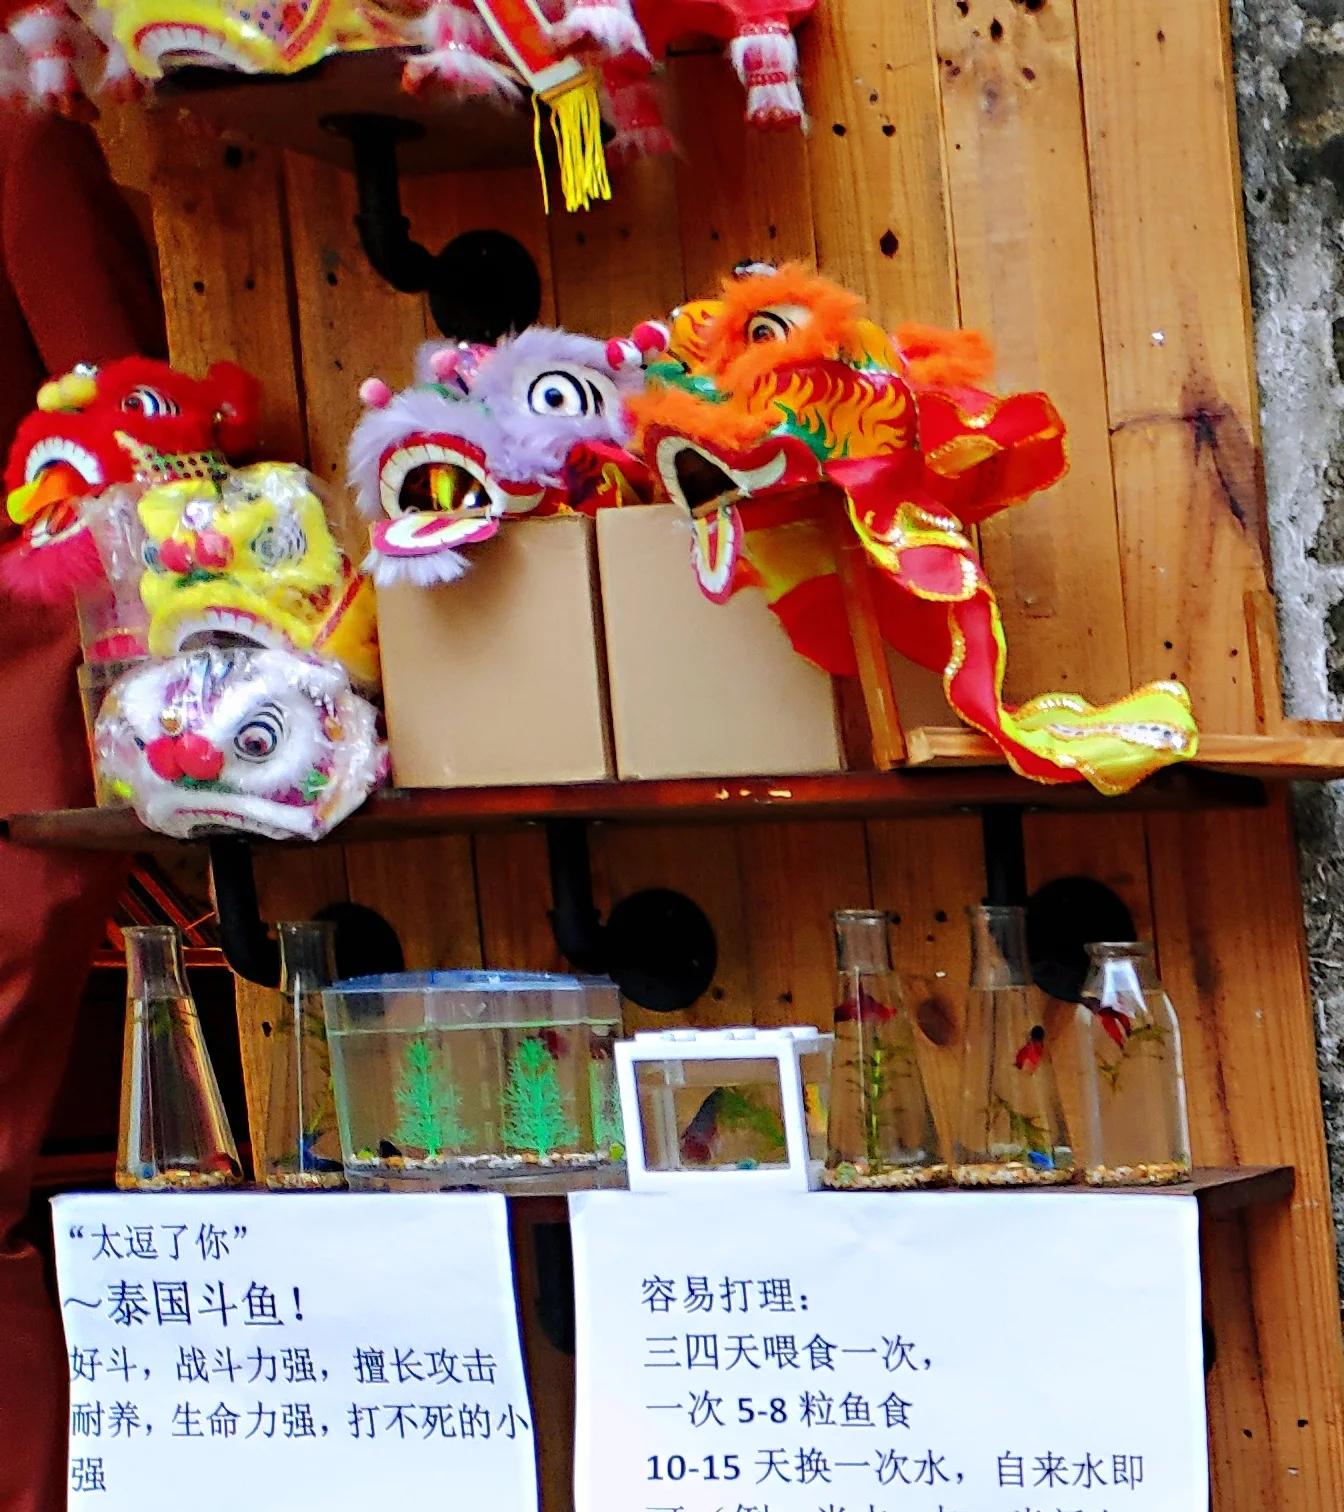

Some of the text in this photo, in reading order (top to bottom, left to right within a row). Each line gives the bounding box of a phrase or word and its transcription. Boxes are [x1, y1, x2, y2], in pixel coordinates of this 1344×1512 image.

[68, 1223, 248, 1261] “太逗了你”
[640, 1274, 810, 1314] 容易打理：
[69, 1345, 498, 1385] 好斗，战斗力强，擅长攻击
[643, 1333, 934, 1373] 三四天喂食一次，
[71, 1401, 530, 1440] 耐养，生命力强，打不死的小
[645, 1389, 913, 1430] 一次 5-8 粒鱼食
[71, 1456, 107, 1493] 强
[646, 1447, 1145, 1490] 10-15 天换一次水，自来水即
